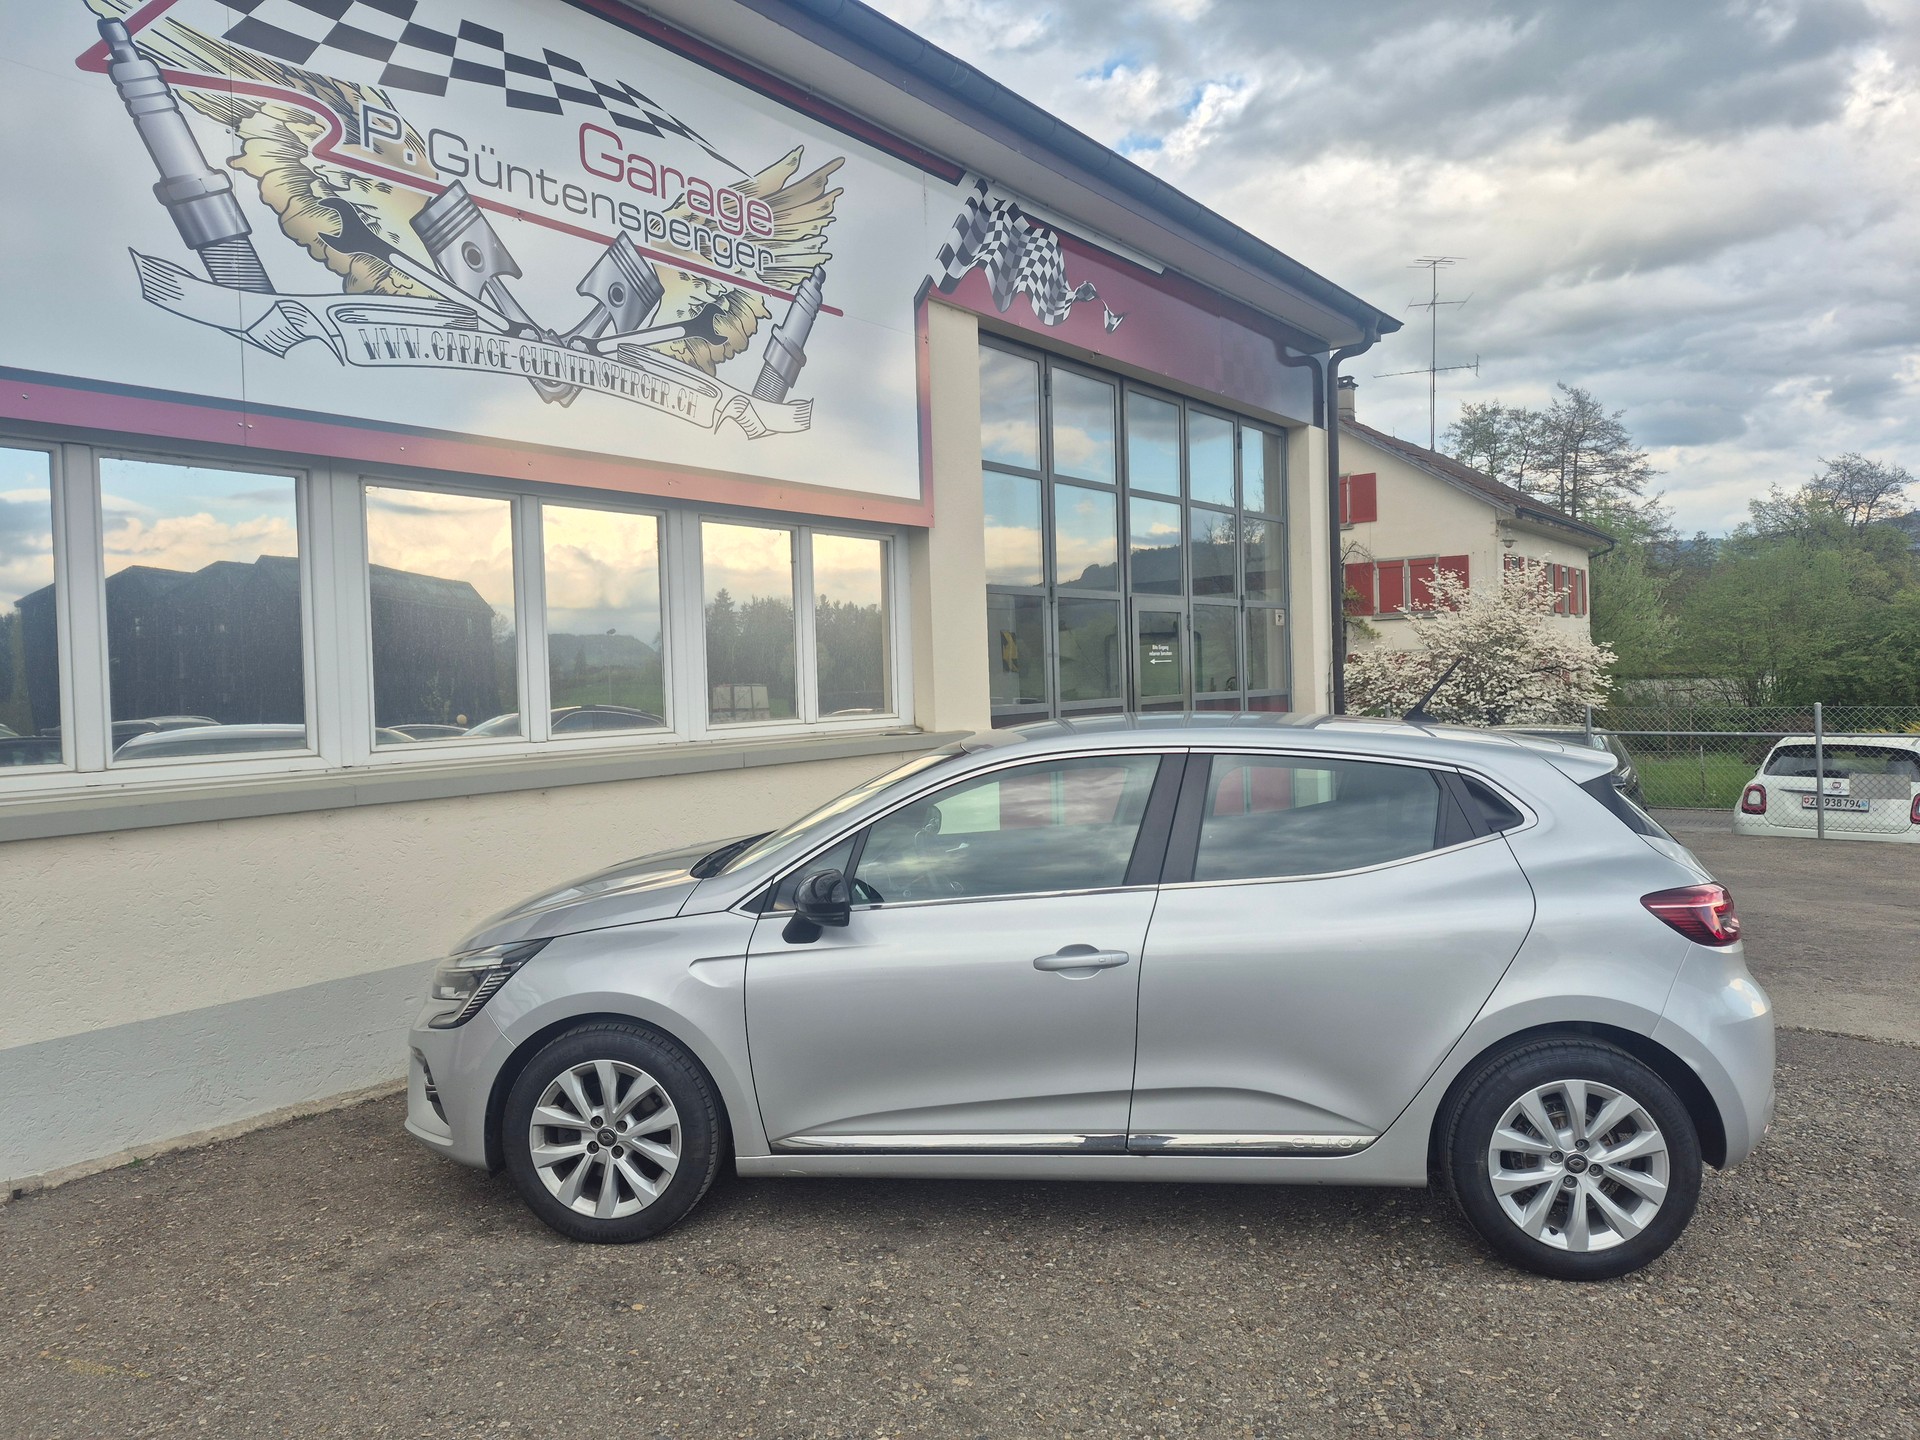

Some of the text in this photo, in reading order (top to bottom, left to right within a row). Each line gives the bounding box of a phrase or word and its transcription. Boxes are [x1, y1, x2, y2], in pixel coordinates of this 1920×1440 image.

[579, 122, 773, 237] Garage
[358, 327, 699, 418] WWW.GARAGE-GUENTENSPERGER.CH
[1810, 797, 1818, 806] Z
